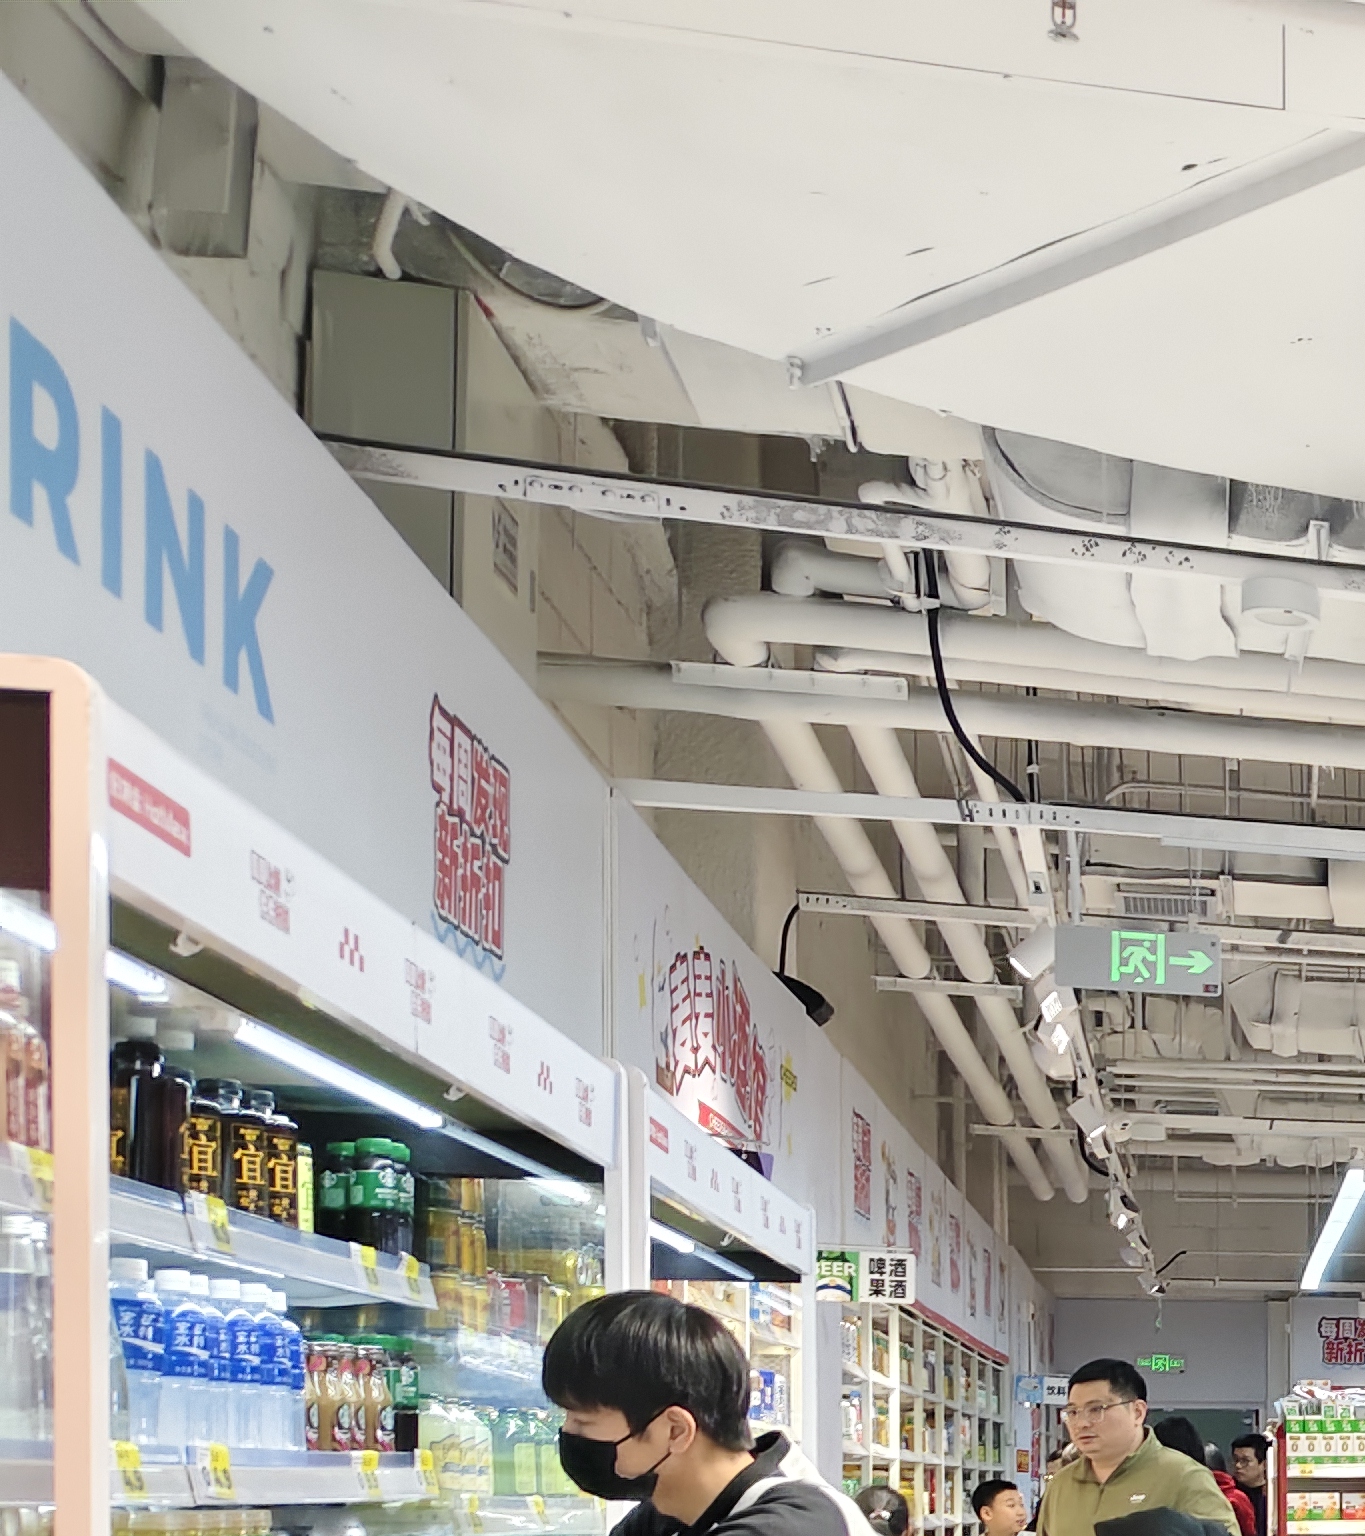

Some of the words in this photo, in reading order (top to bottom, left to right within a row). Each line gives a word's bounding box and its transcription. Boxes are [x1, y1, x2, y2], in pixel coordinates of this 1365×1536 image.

[430, 693, 511, 863] 每周发现
[434, 800, 503, 961] 新折扣
[188, 1137, 218, 1178] 宜
[233, 1143, 265, 1184] 宜
[267, 1154, 297, 1194] 宜
[868, 1257, 908, 1278] 啤酒
[868, 1279, 908, 1299] 果酒
